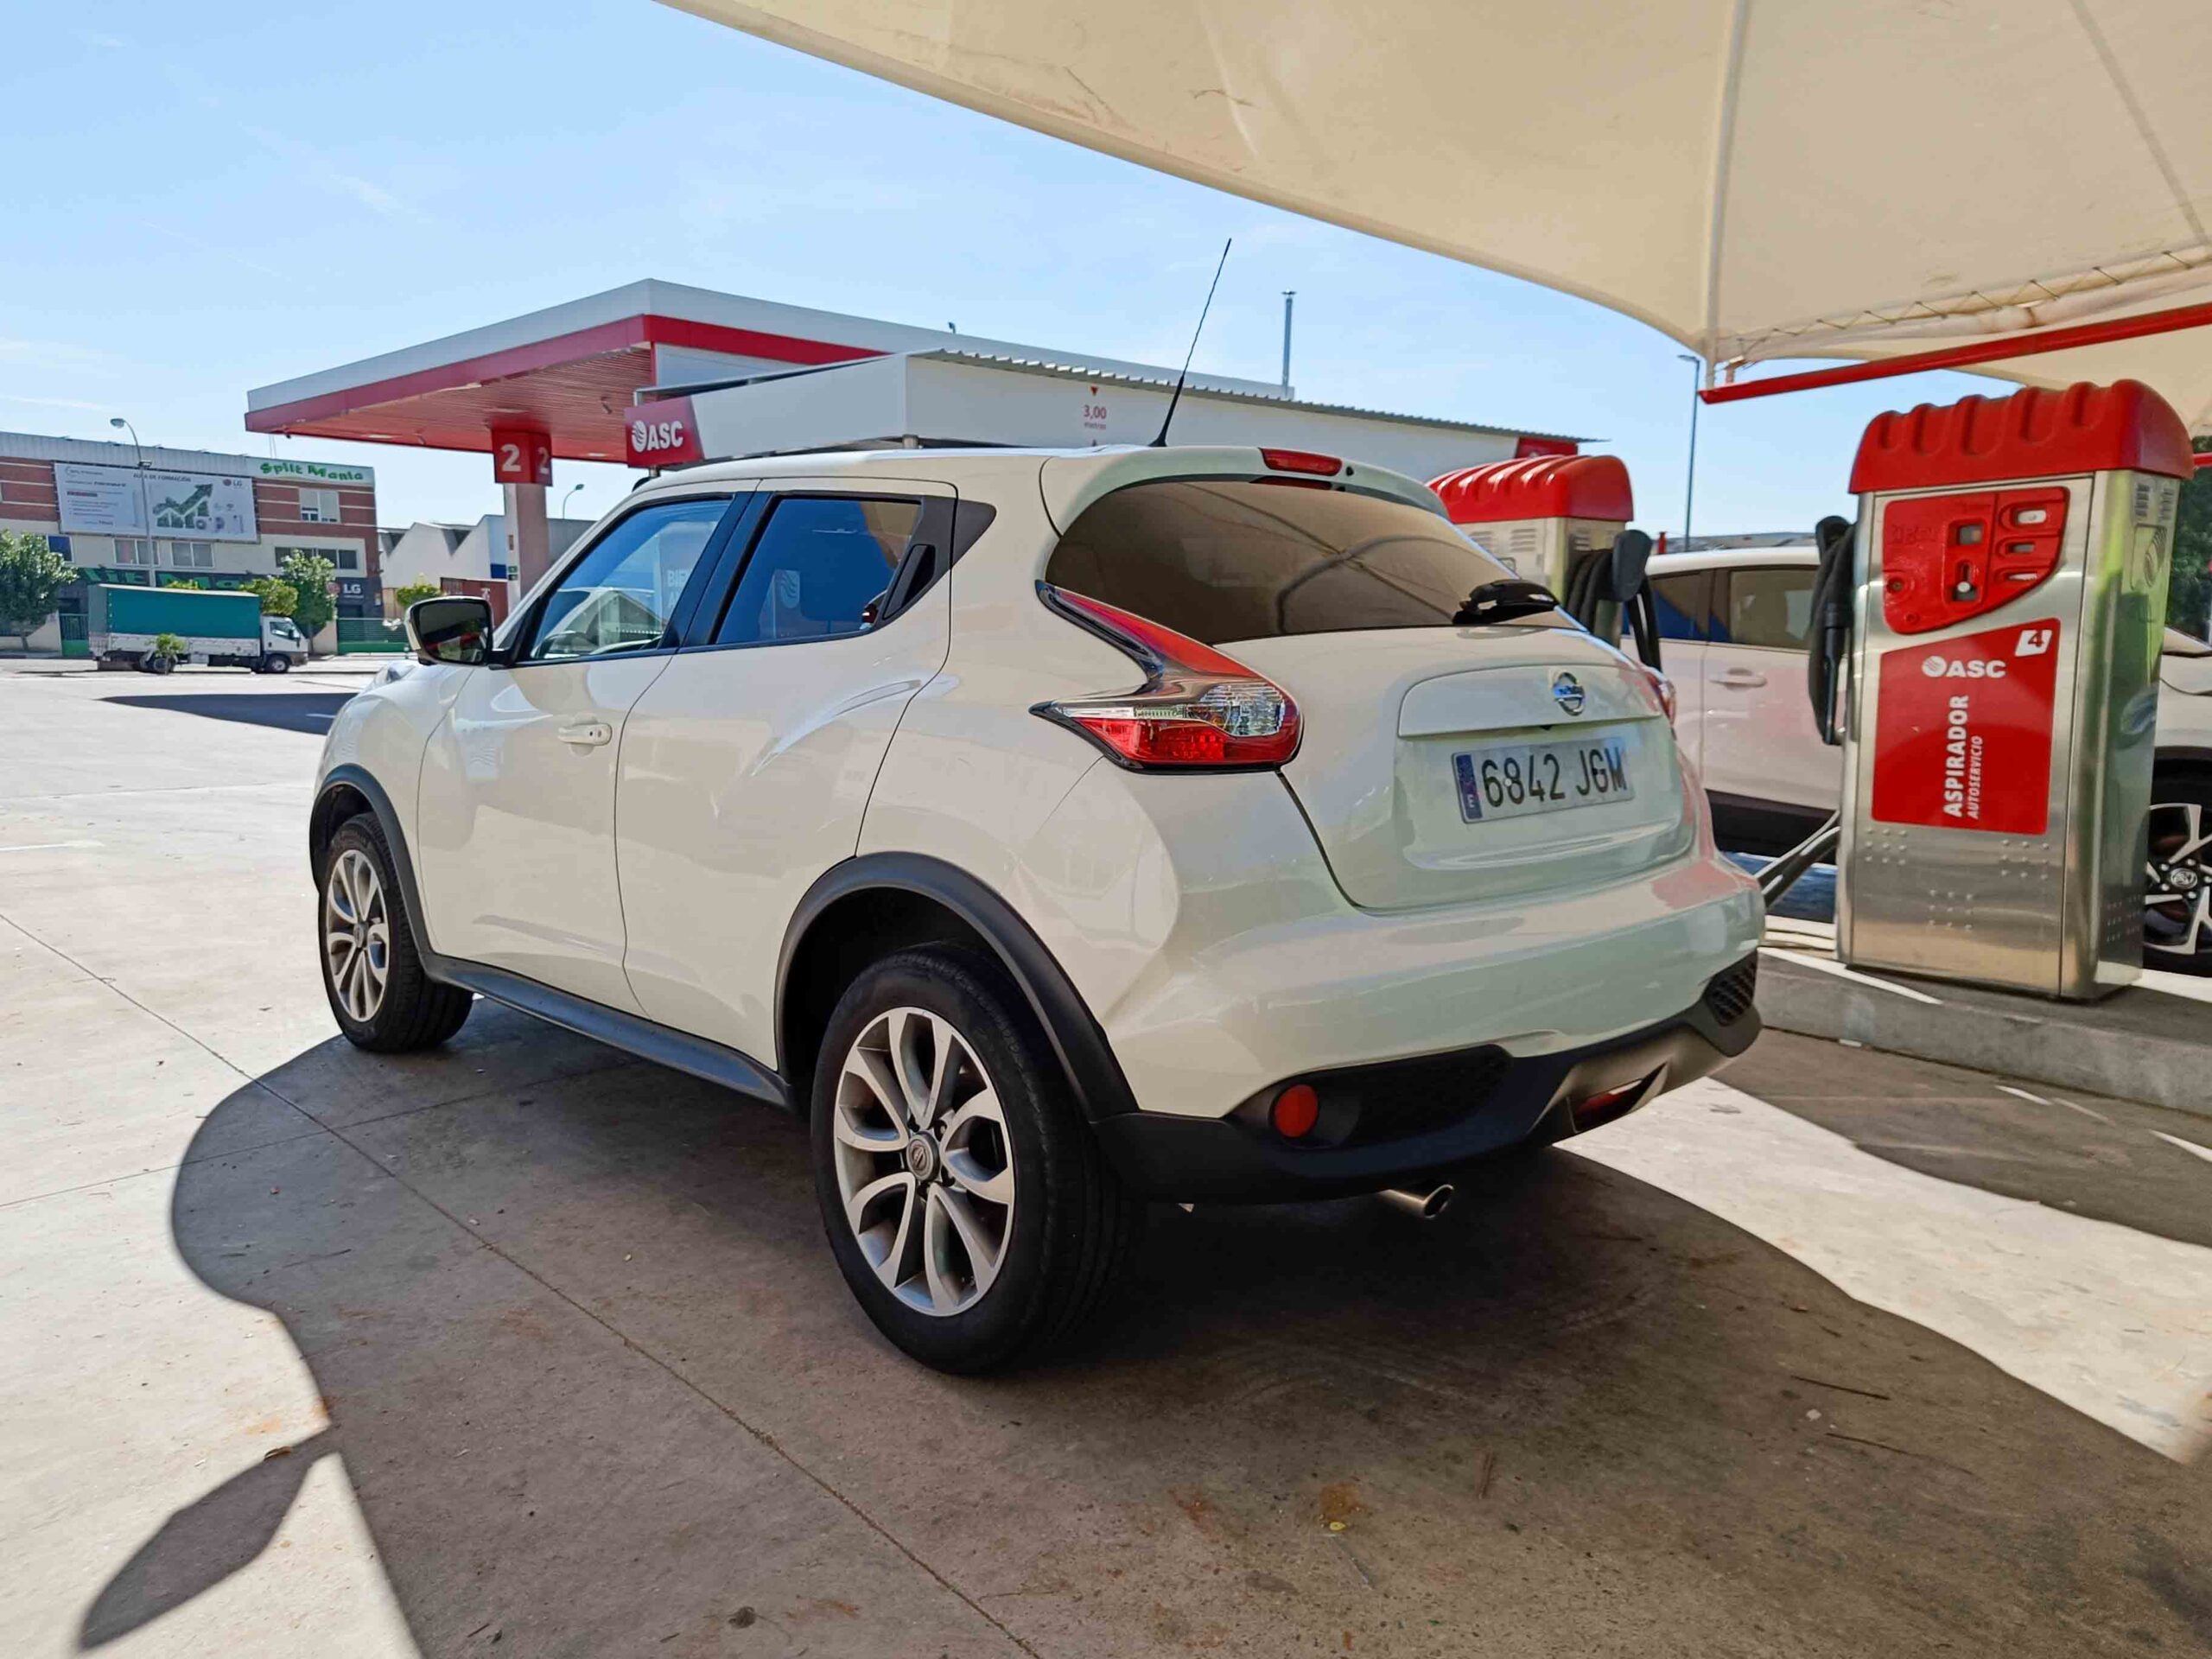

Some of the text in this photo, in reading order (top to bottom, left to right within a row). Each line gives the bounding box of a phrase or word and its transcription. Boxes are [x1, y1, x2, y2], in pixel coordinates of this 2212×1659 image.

[1084, 404, 1107, 419] 3,00
[647, 421, 683, 451] ASC
[260, 462, 363, 480] Split Mania
[501, 444, 520, 472] 2
[537, 447, 550, 474] 2
[343, 584, 361, 594] LG
[2028, 631, 2044, 648] 4
[1946, 660, 2006, 678] ASC
[1943, 695, 1969, 817] ASPIRADOR
[1481, 753, 1566, 807] 6842
[1967, 735, 1983, 820] AUTOSERVICIO
